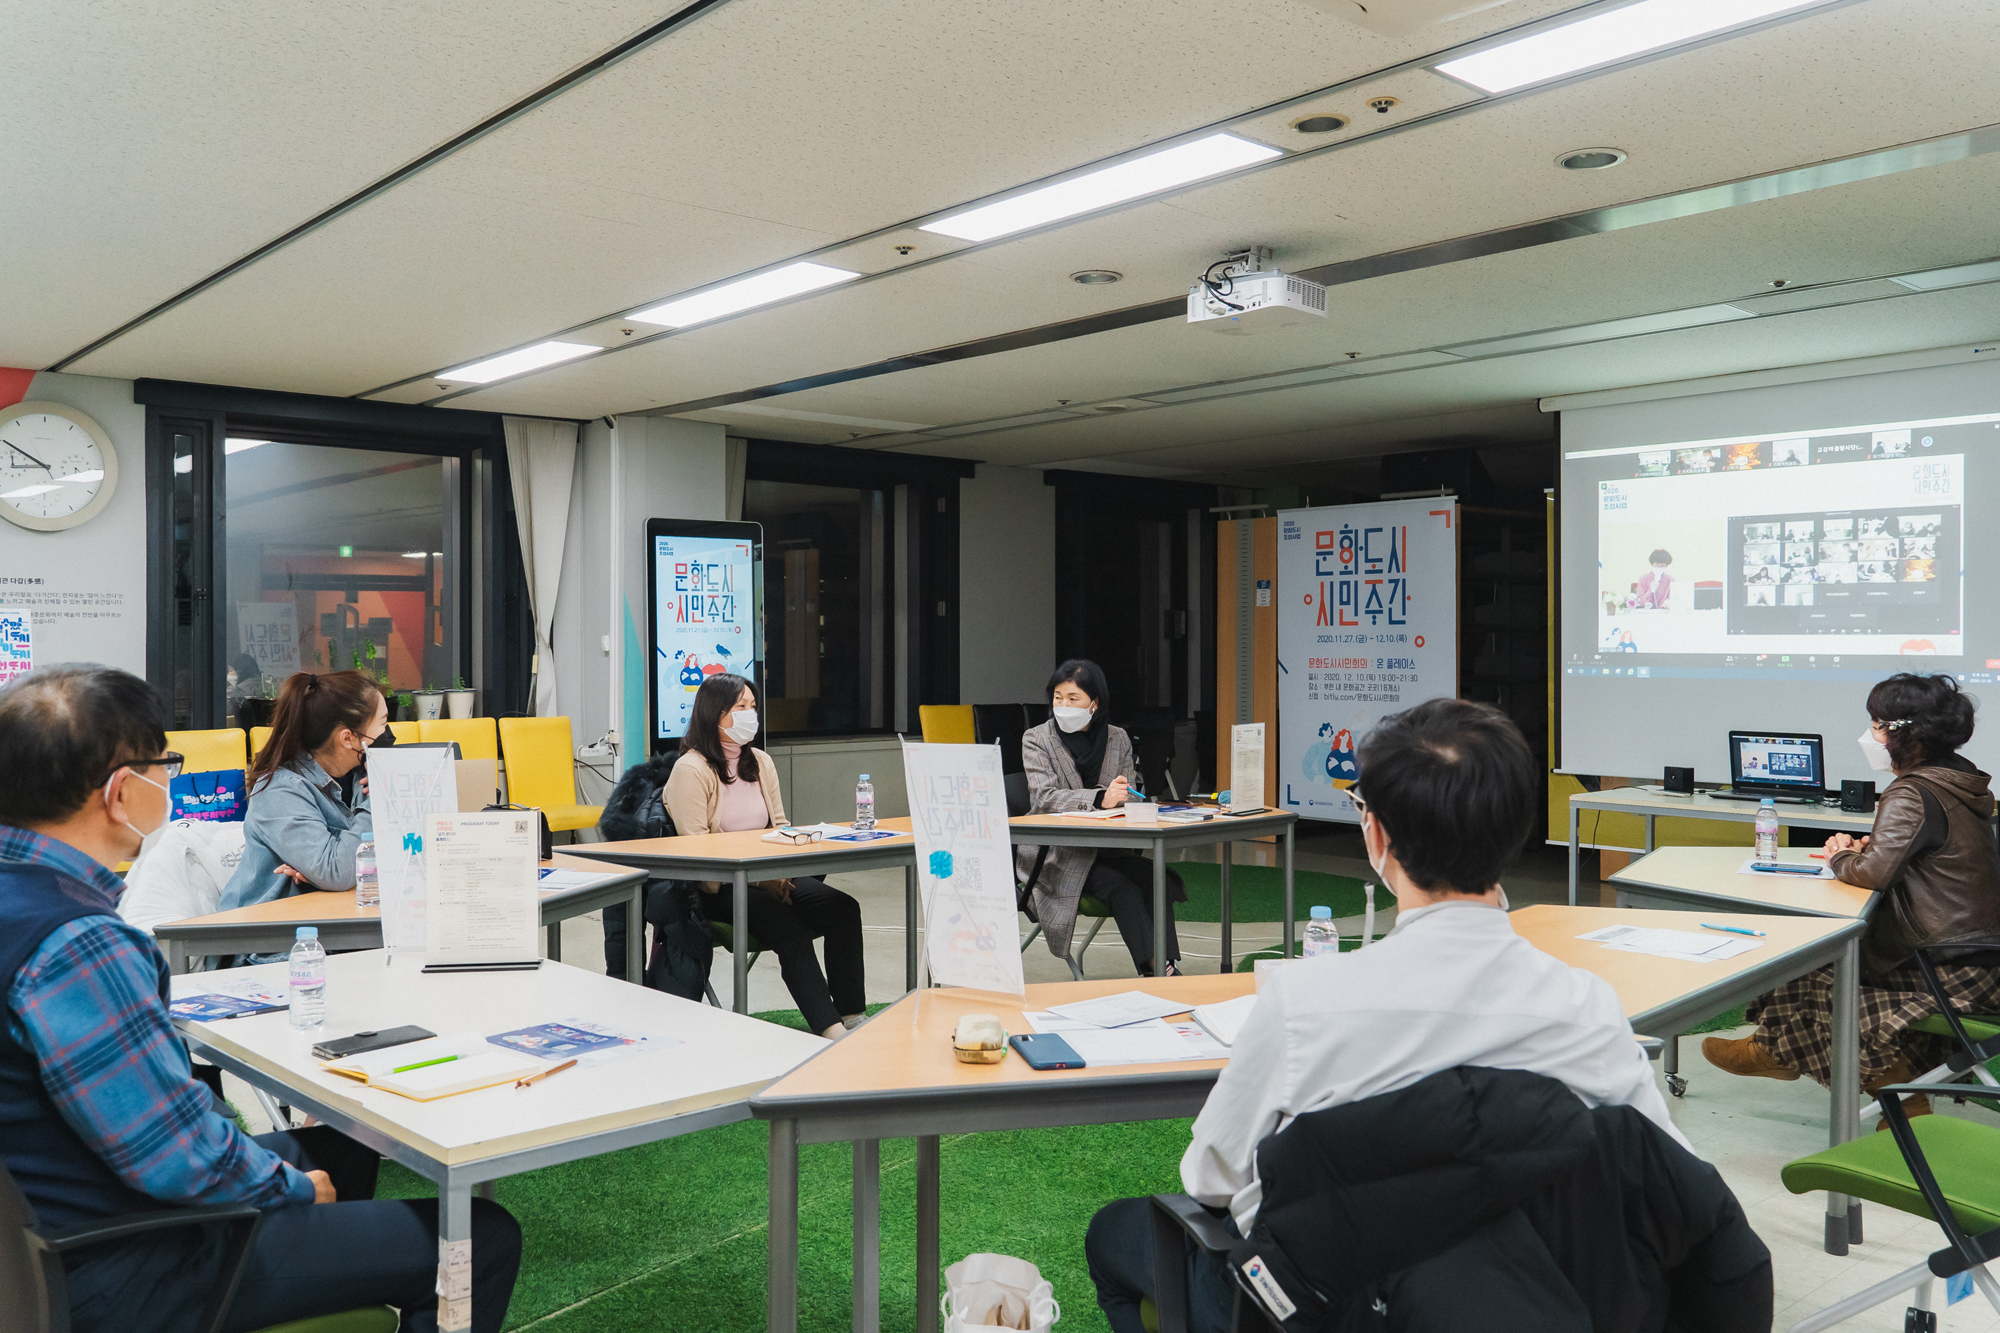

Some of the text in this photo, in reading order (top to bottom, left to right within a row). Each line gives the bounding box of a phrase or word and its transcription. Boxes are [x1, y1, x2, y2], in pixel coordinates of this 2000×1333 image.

[1912, 462, 1950, 479] 문화도시
[1316, 523, 1406, 576] 문화도시
[675, 560, 734, 592] 문화도시
[676, 595, 736, 623] 시민주간
[1316, 578, 1411, 626] 시민주간
[1316, 635, 1368, 644] 2020.11.27.(금)
[1308, 658, 1368, 669] 문화도시시민회의
[1376, 658, 1384, 669] 온
[1387, 658, 1416, 670] 플레이스
[1324, 673, 1342, 681] 2020.
[1378, 674, 1418, 682] 19:00~21:30
[1259, 1276, 1288, 1314] swisscom
